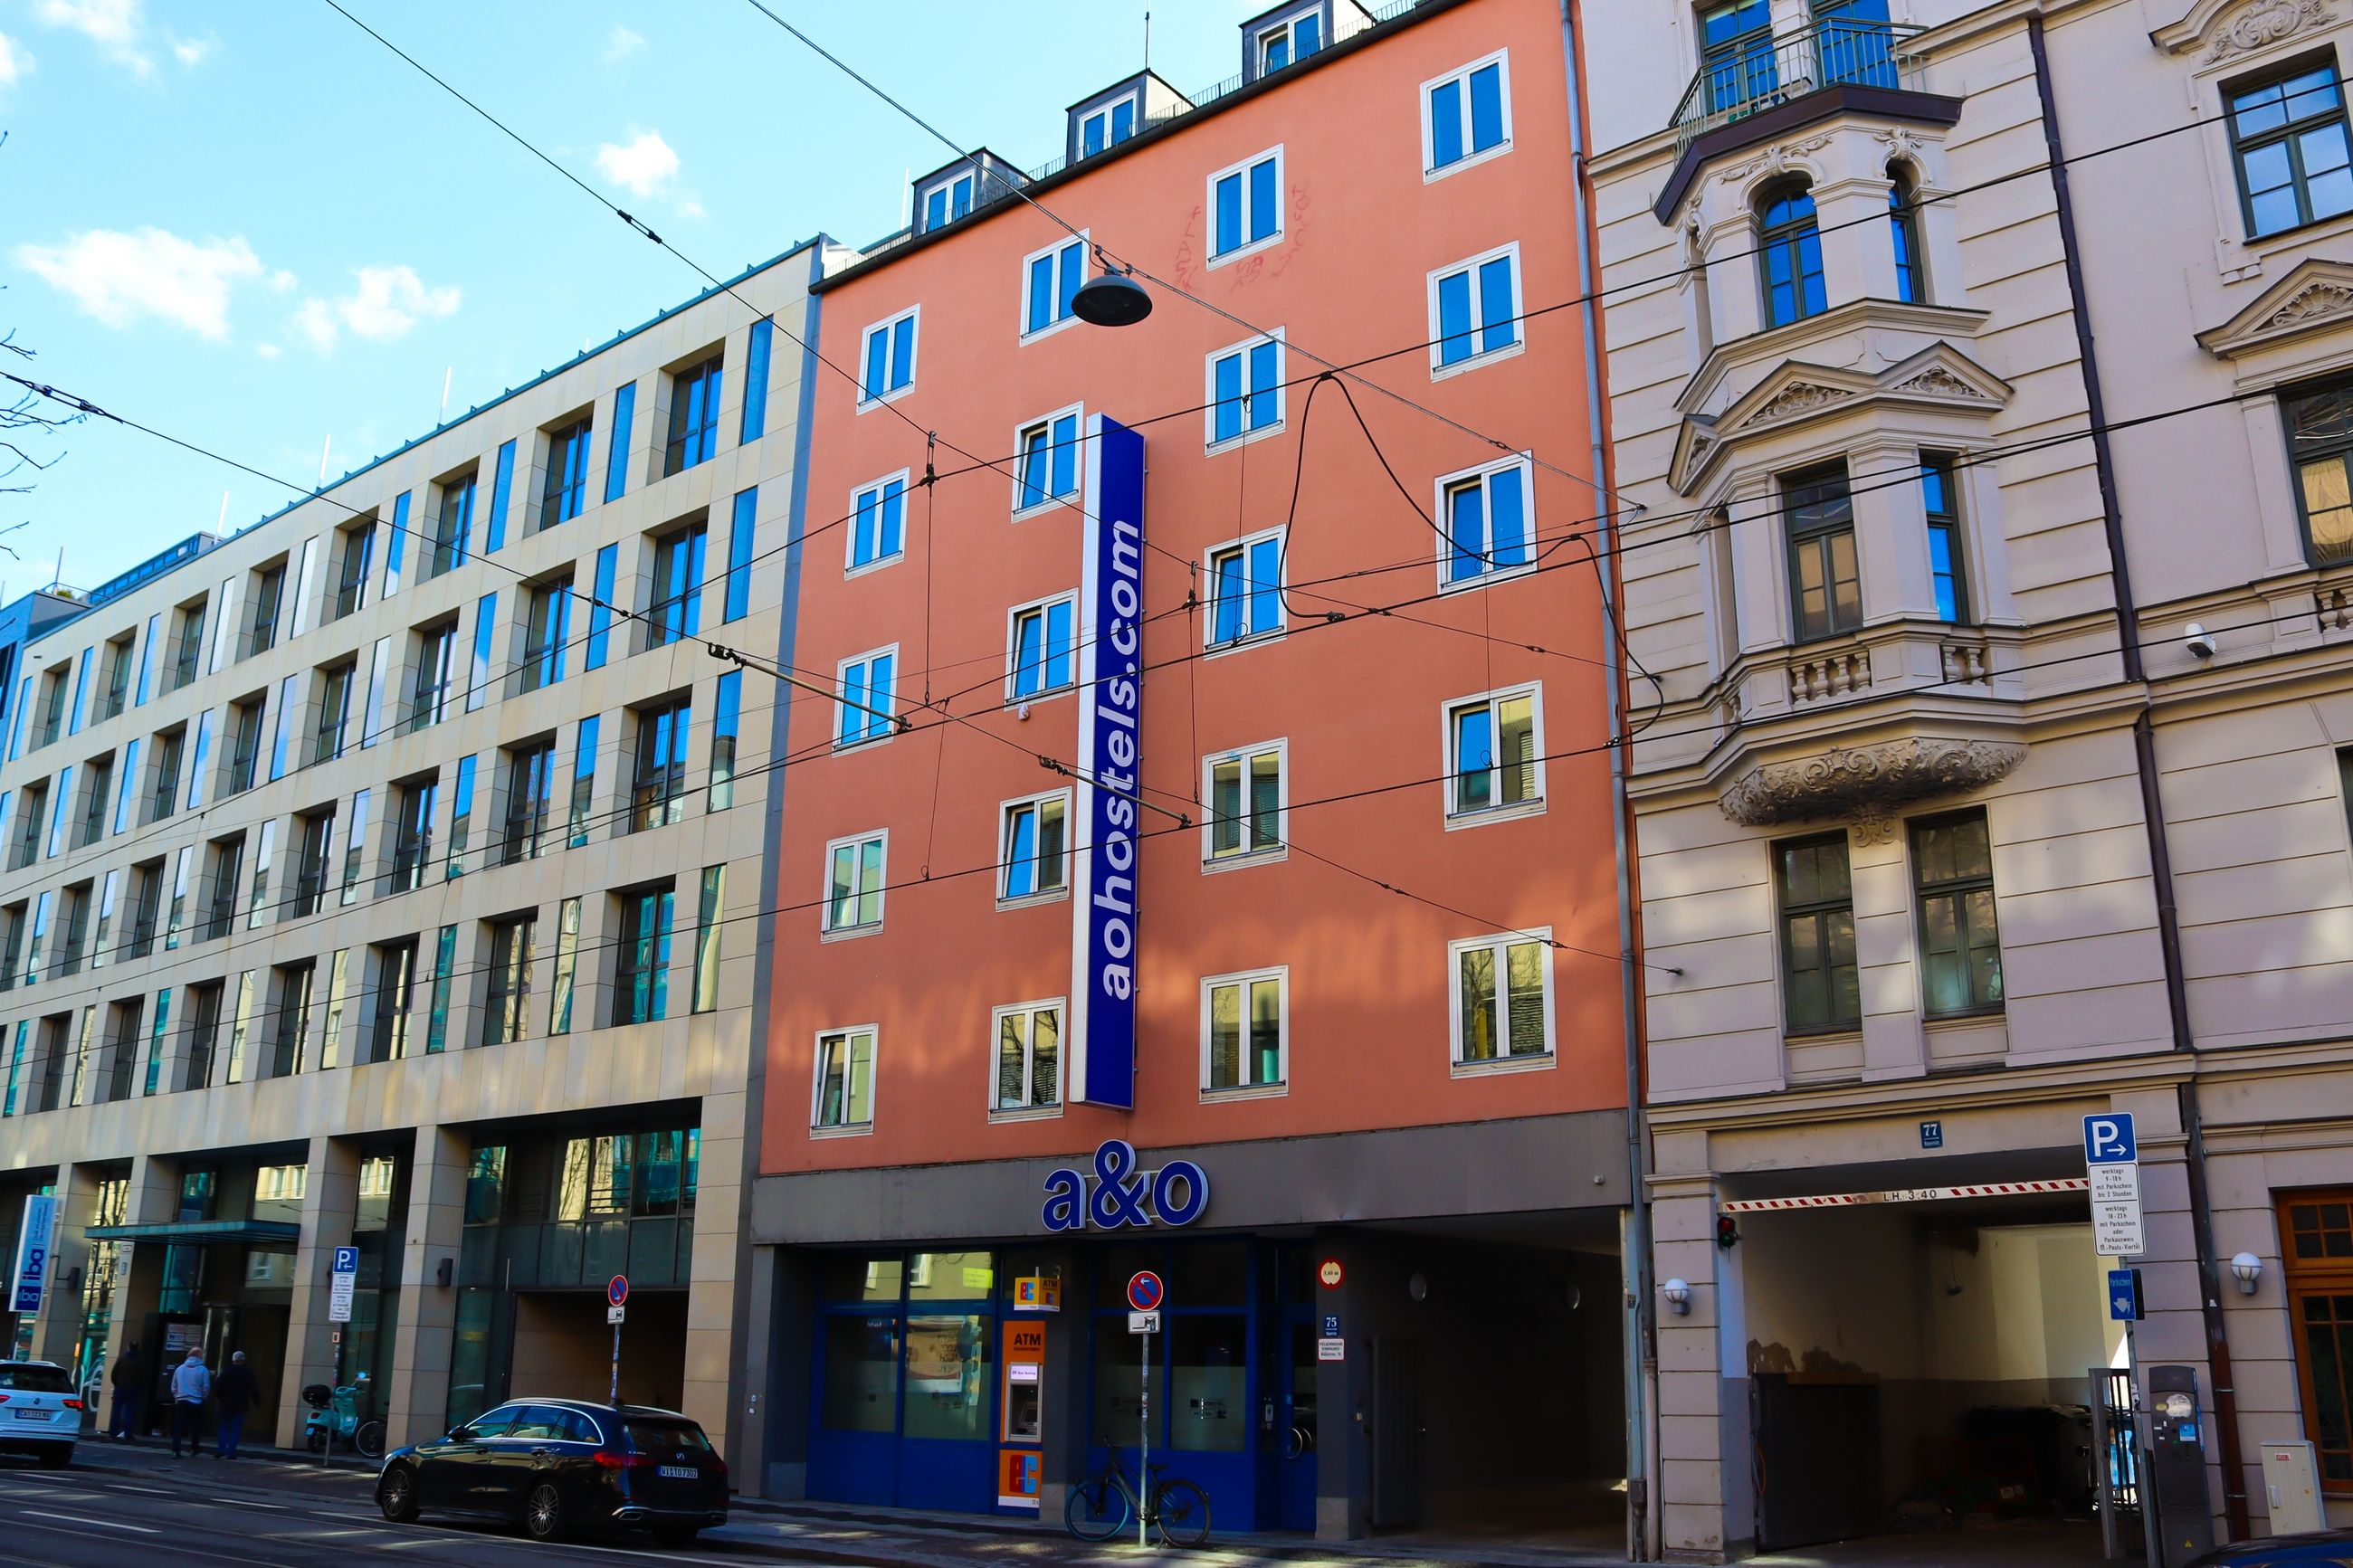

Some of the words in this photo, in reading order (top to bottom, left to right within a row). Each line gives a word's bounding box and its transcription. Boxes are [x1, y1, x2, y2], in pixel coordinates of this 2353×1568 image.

[1094, 519, 1139, 1001] aohostels.com
[1922, 1123, 1938, 1136] 77
[2091, 1120, 2119, 1157] P
[1042, 1138, 1209, 1231] a&o
[22, 1249, 44, 1280] iba
[338, 1250, 350, 1269] P
[1043, 1279, 1058, 1288] ATM
[18, 1289, 39, 1302] iba
[1326, 1317, 1337, 1327] 75
[1014, 1333, 1041, 1346] ATM
